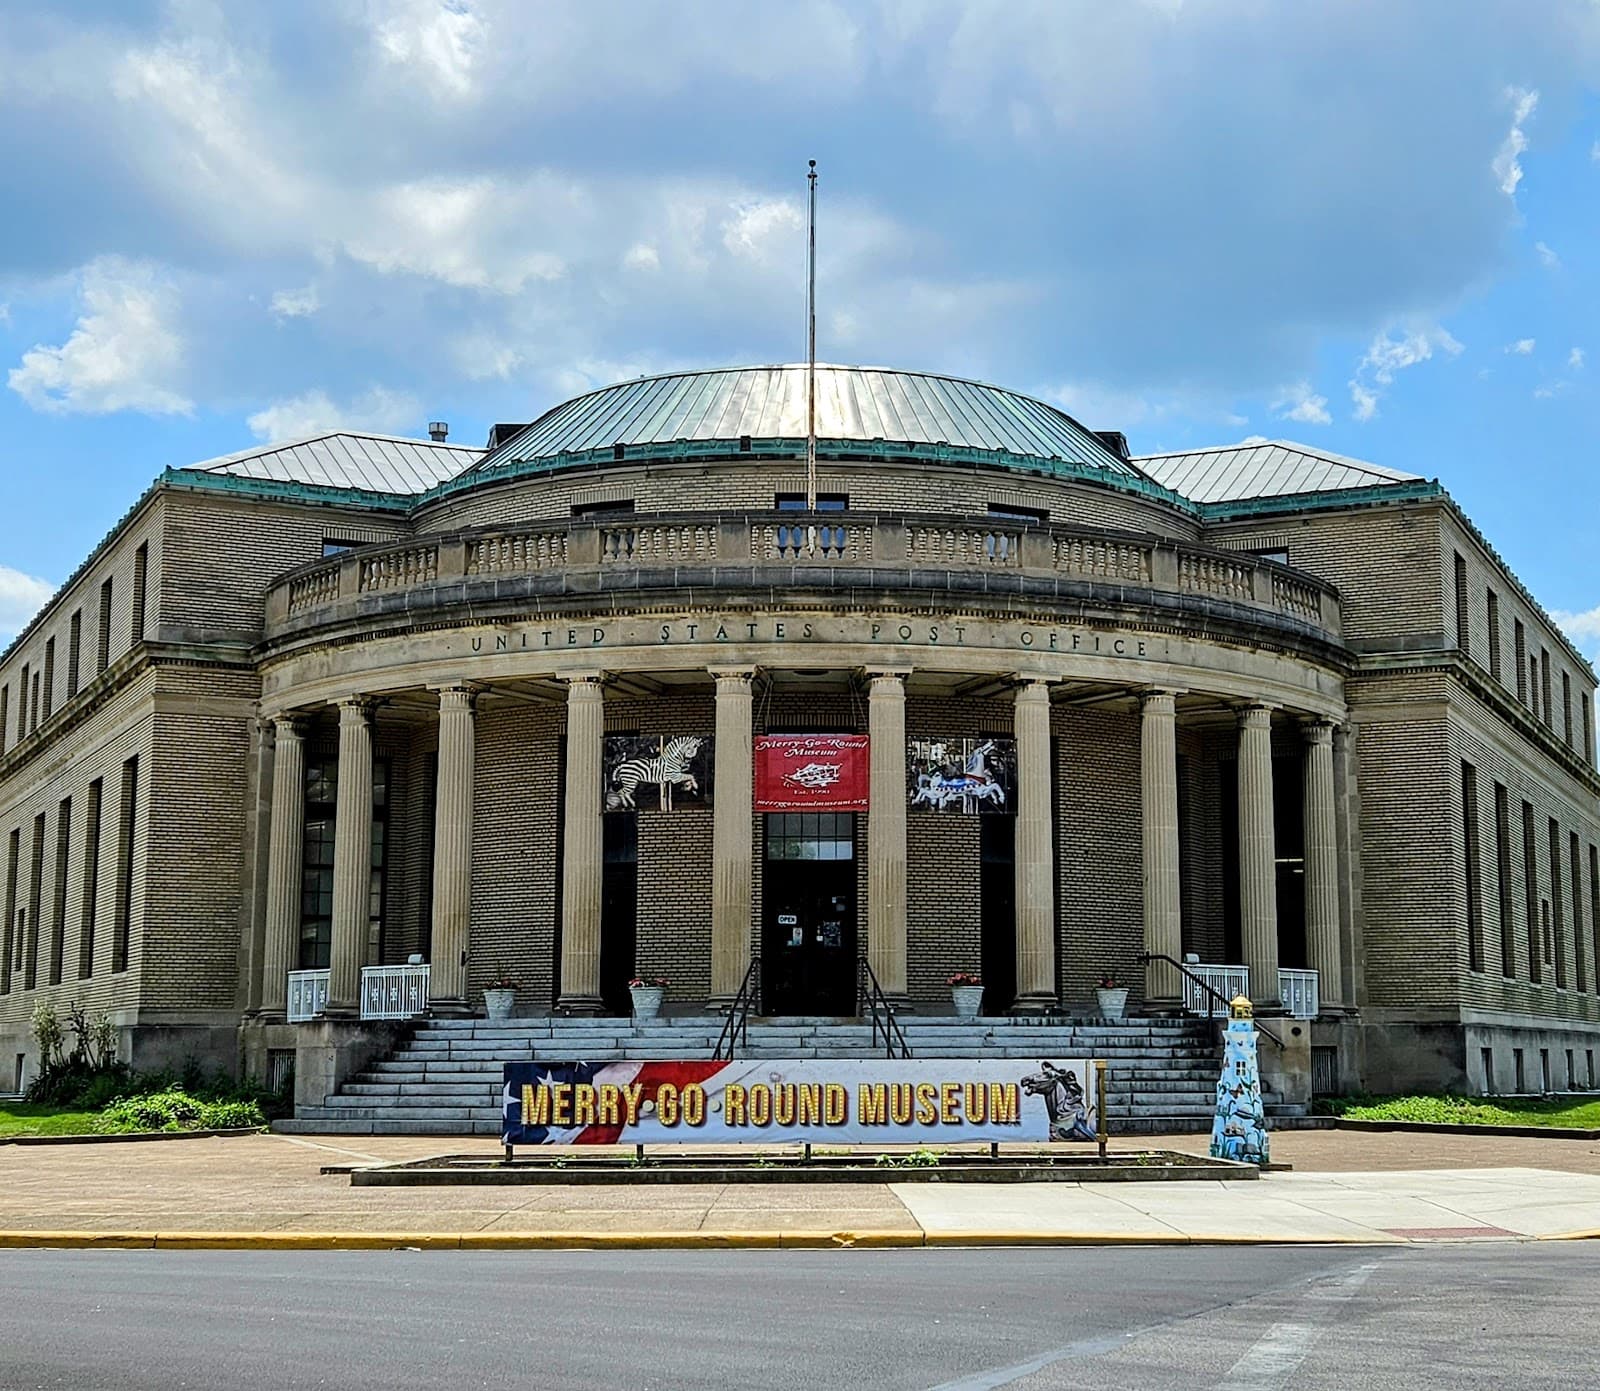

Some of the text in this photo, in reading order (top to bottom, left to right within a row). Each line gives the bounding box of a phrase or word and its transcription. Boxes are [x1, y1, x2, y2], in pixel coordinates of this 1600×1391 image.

[471, 623, 1147, 656] UNITED STATES POST OFFICE
[784, 748, 838, 757] Museum
[858, 1082, 1020, 1125] MUSEUM
